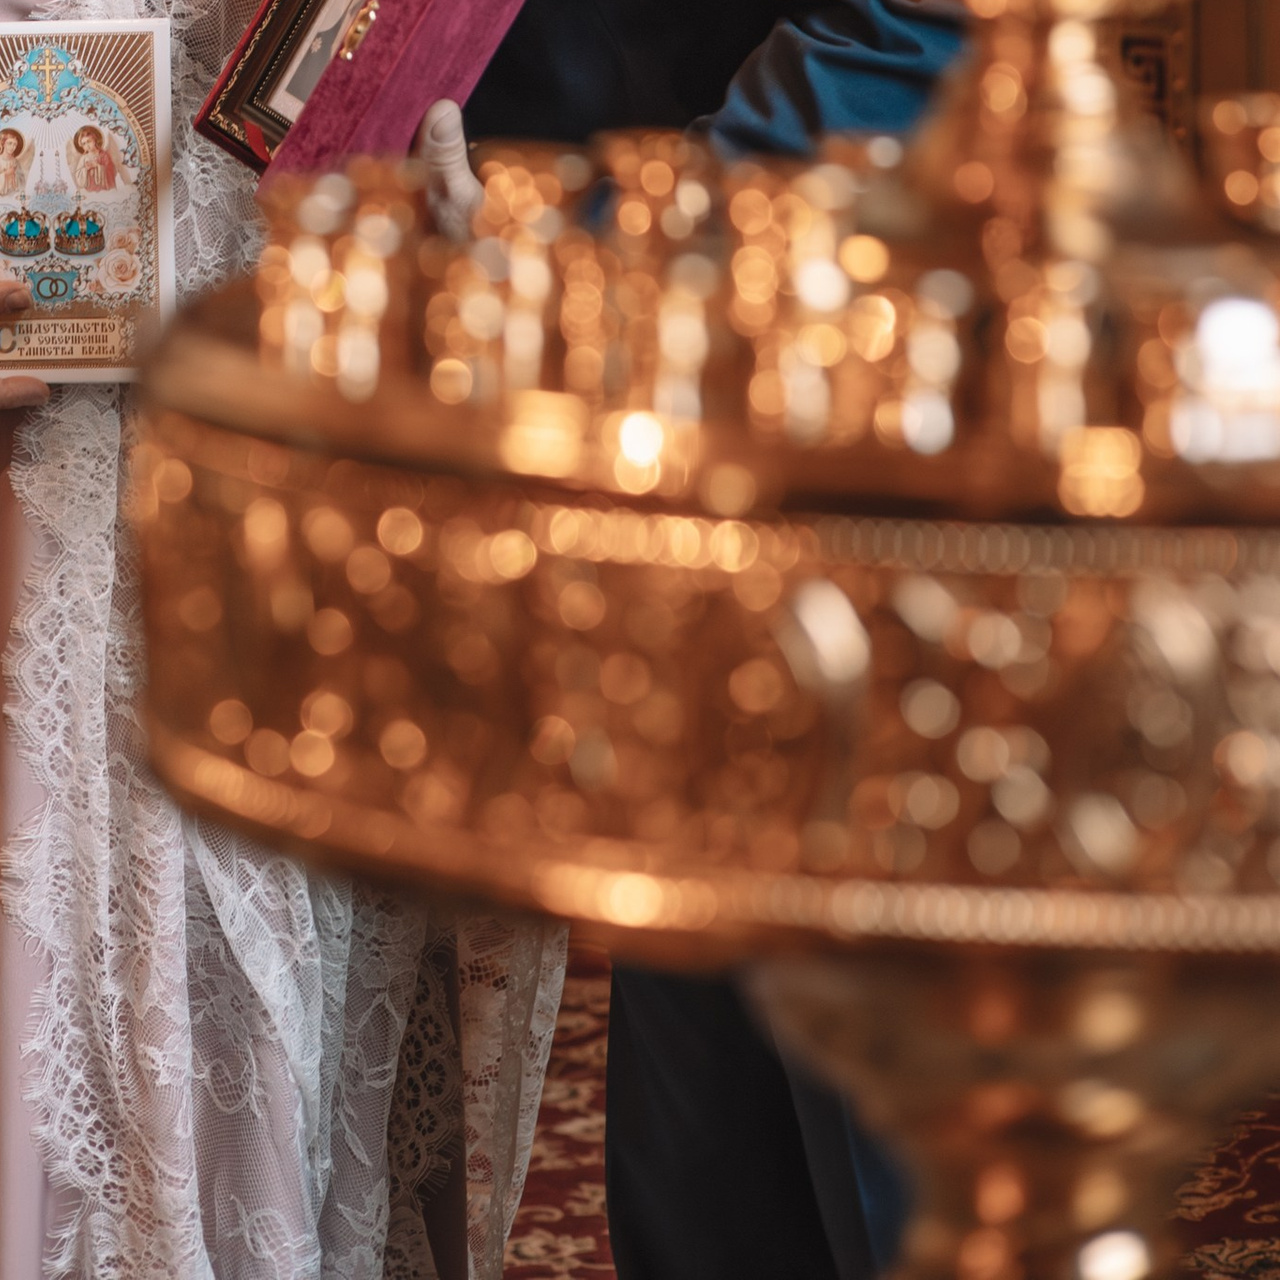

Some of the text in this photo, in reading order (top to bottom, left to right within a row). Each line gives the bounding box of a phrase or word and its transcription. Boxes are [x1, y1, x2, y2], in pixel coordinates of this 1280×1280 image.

[23, 334, 108, 345] О СОВЕРШЕНИИ
[17, 345, 116, 357] ТАИНСТВА БРАКА
